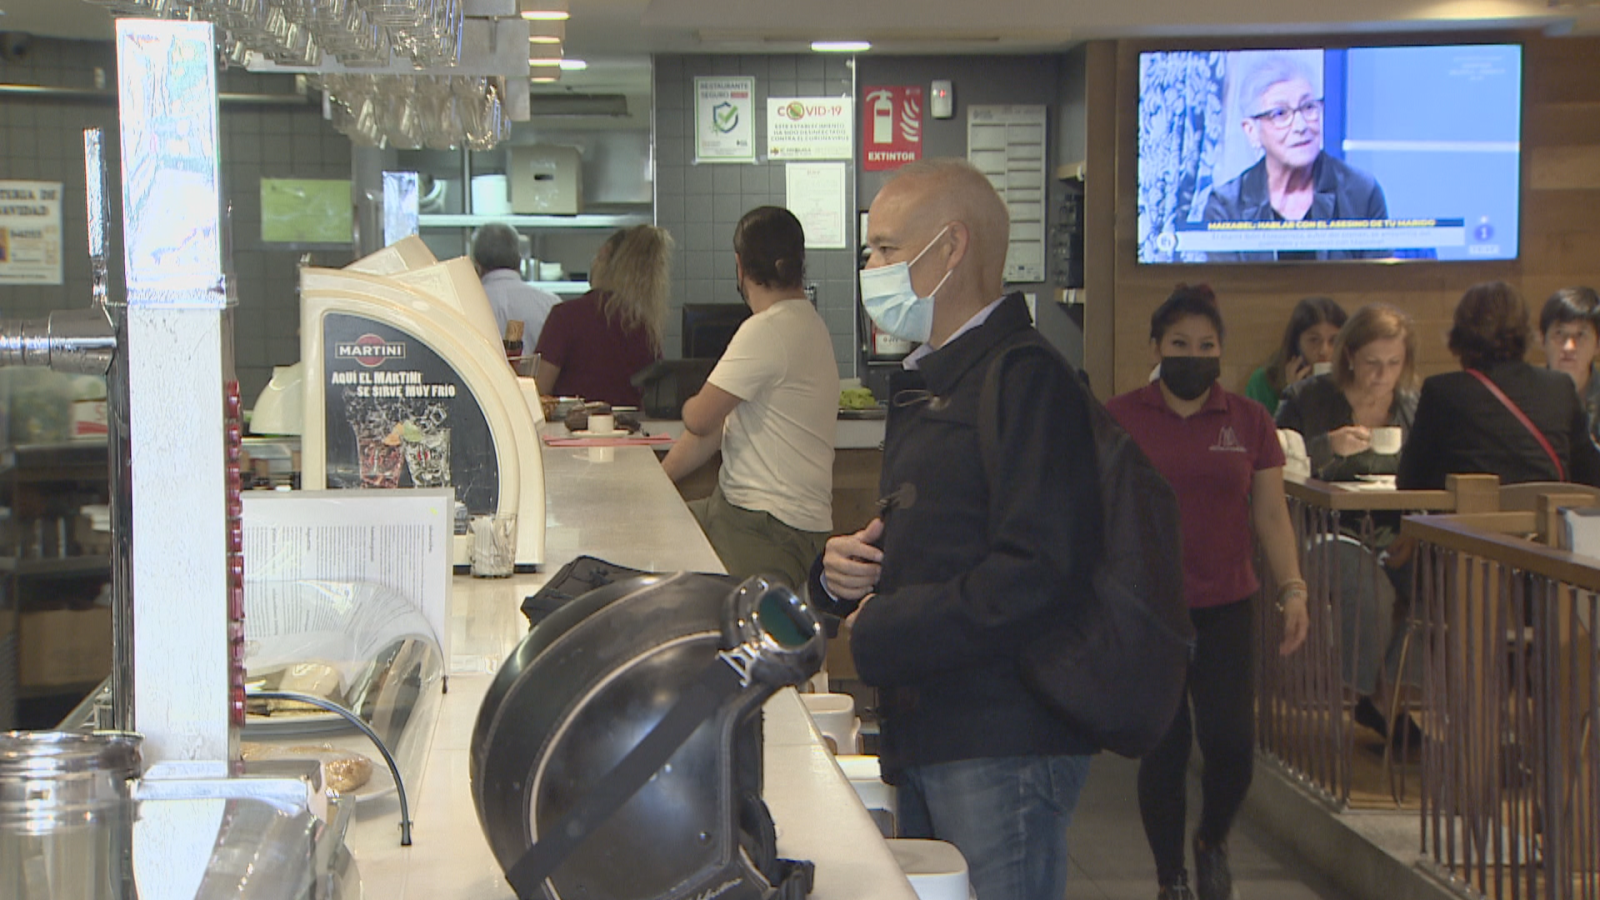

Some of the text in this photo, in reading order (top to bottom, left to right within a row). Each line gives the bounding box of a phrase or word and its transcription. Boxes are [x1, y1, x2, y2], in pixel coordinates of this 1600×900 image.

[700, 82, 748, 90] RESTAURANTE
[868, 152, 915, 161] EXTINTOR
[1257, 221, 1295, 230] HABLAR
[1296, 220, 1316, 229] CON
[1317, 220, 1328, 229] EL
[1330, 220, 1369, 228] ASESINO
[1370, 219, 1383, 228] DE
[1385, 219, 1397, 227] TU
[1398, 219, 1436, 227] MARIDO
[340, 345, 402, 356] MARTINI
[331, 370, 422, 384] AQUÍ EL MARTINI
[357, 383, 456, 397] SE SIRVE MUY FRÍO
